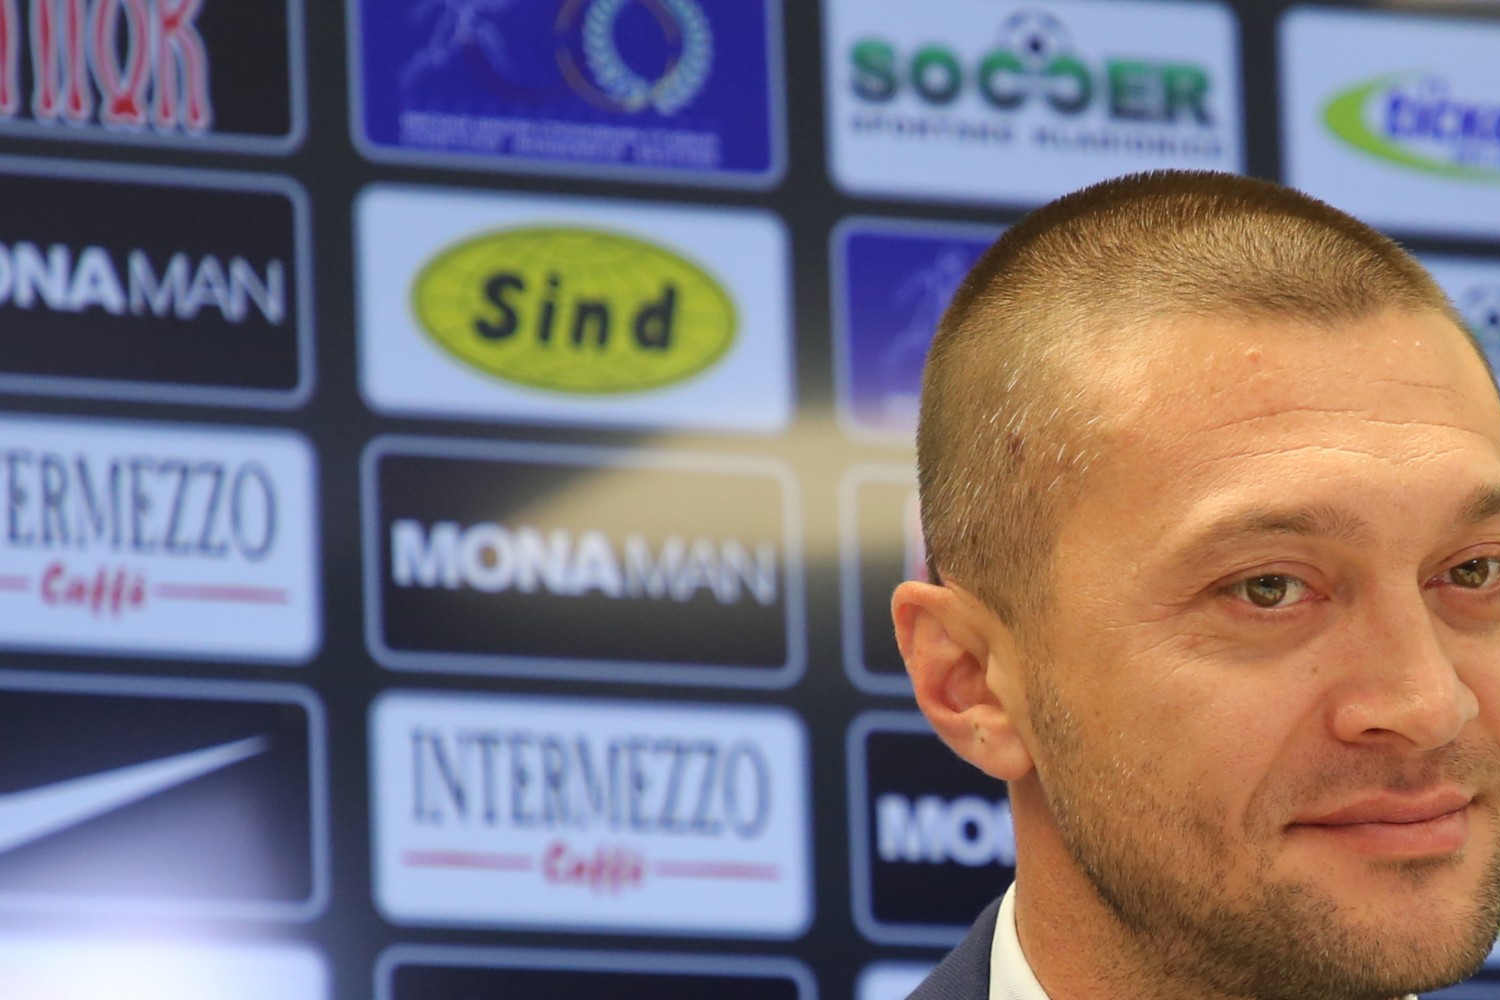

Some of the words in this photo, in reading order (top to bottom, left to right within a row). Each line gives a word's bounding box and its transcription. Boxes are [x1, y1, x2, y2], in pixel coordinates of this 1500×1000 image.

[850, 37, 1220, 127] SOCCER
[472, 270, 679, 353] Sind
[409, 727, 774, 841] INTERMEZZO
